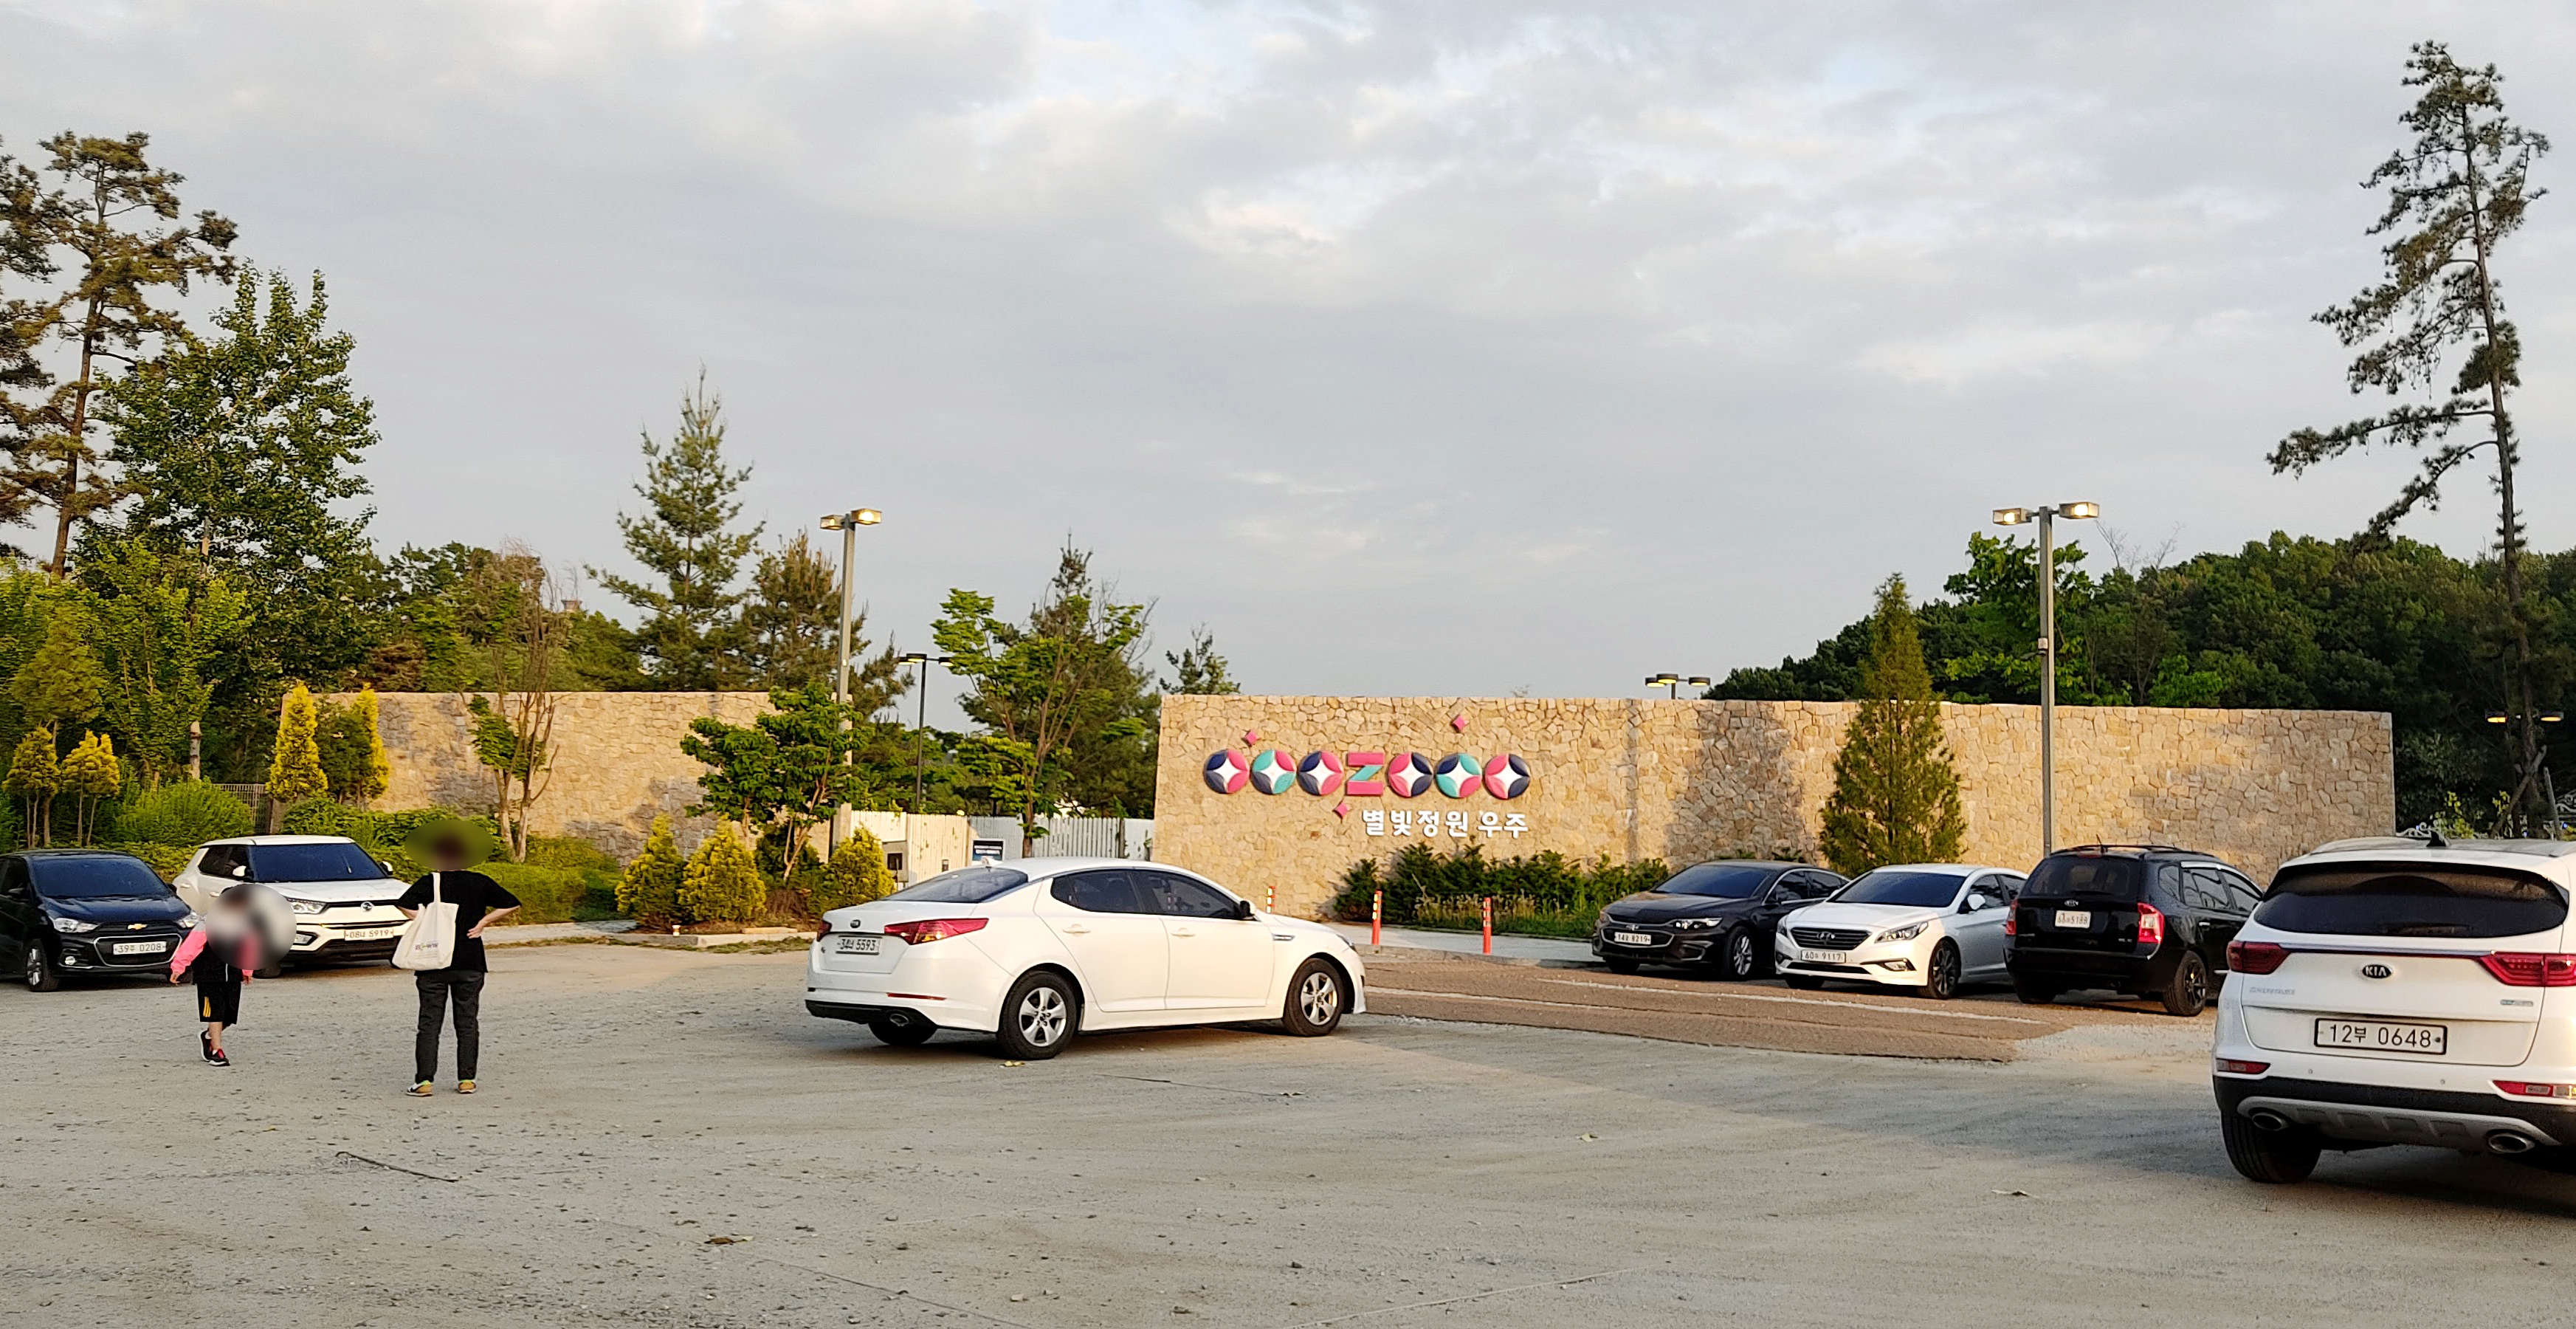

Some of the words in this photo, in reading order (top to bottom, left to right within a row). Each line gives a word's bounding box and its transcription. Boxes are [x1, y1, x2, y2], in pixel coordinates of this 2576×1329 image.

[1362, 809, 1469, 837] 별빛정원
[1476, 811, 1529, 839] 우주
[140, 943, 162, 952] 0208
[856, 939, 877, 951] 5593
[1822, 952, 1841, 961] 9117
[2364, 965, 2388, 977] KIA
[2329, 1023, 2367, 1044] 12부
[2377, 1026, 2431, 1048] 0648
